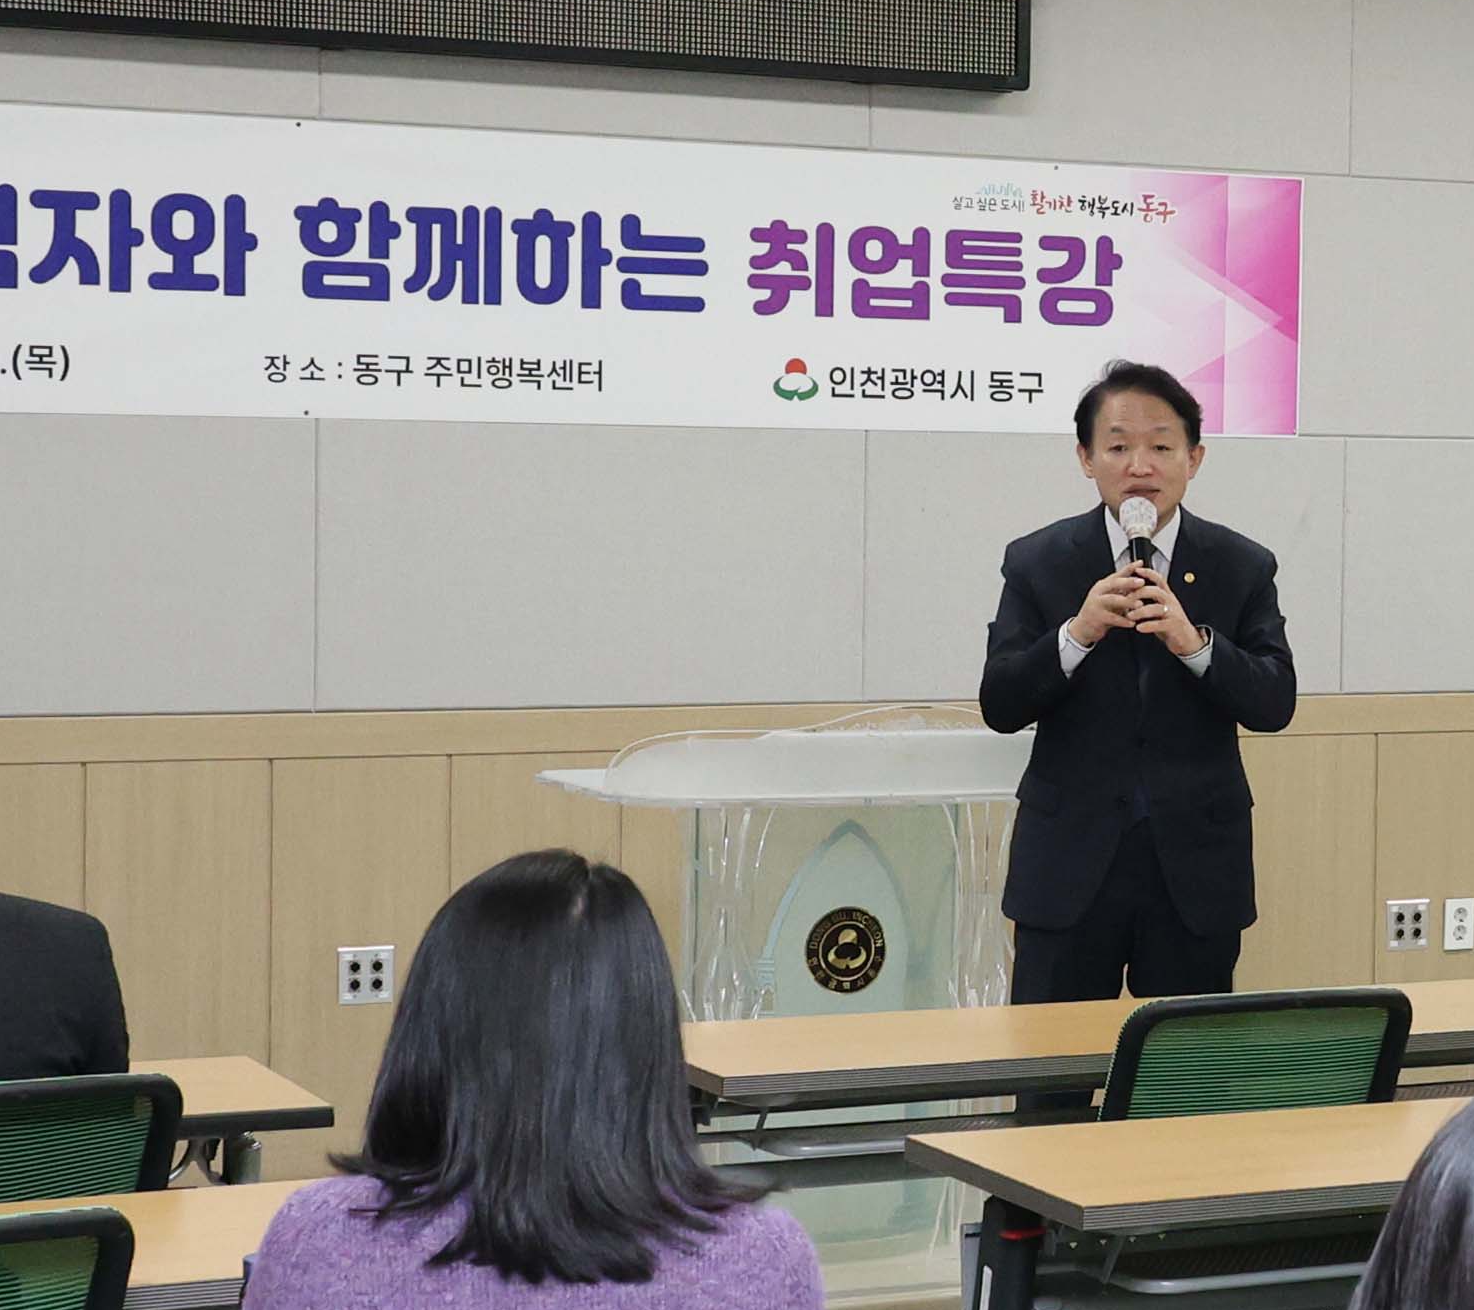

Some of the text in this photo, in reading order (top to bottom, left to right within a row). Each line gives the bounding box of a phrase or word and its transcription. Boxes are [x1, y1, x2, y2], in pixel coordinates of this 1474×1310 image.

[1029, 190, 1176, 224] 활기찬 행복도시 동구
[293, 197, 709, 313] 함께하는
[747, 222, 1123, 327] 취업특강
[352, 353, 414, 387] 동구
[423, 356, 604, 392] 주민행복센터
[829, 366, 1045, 404] 인천광역시 동구
